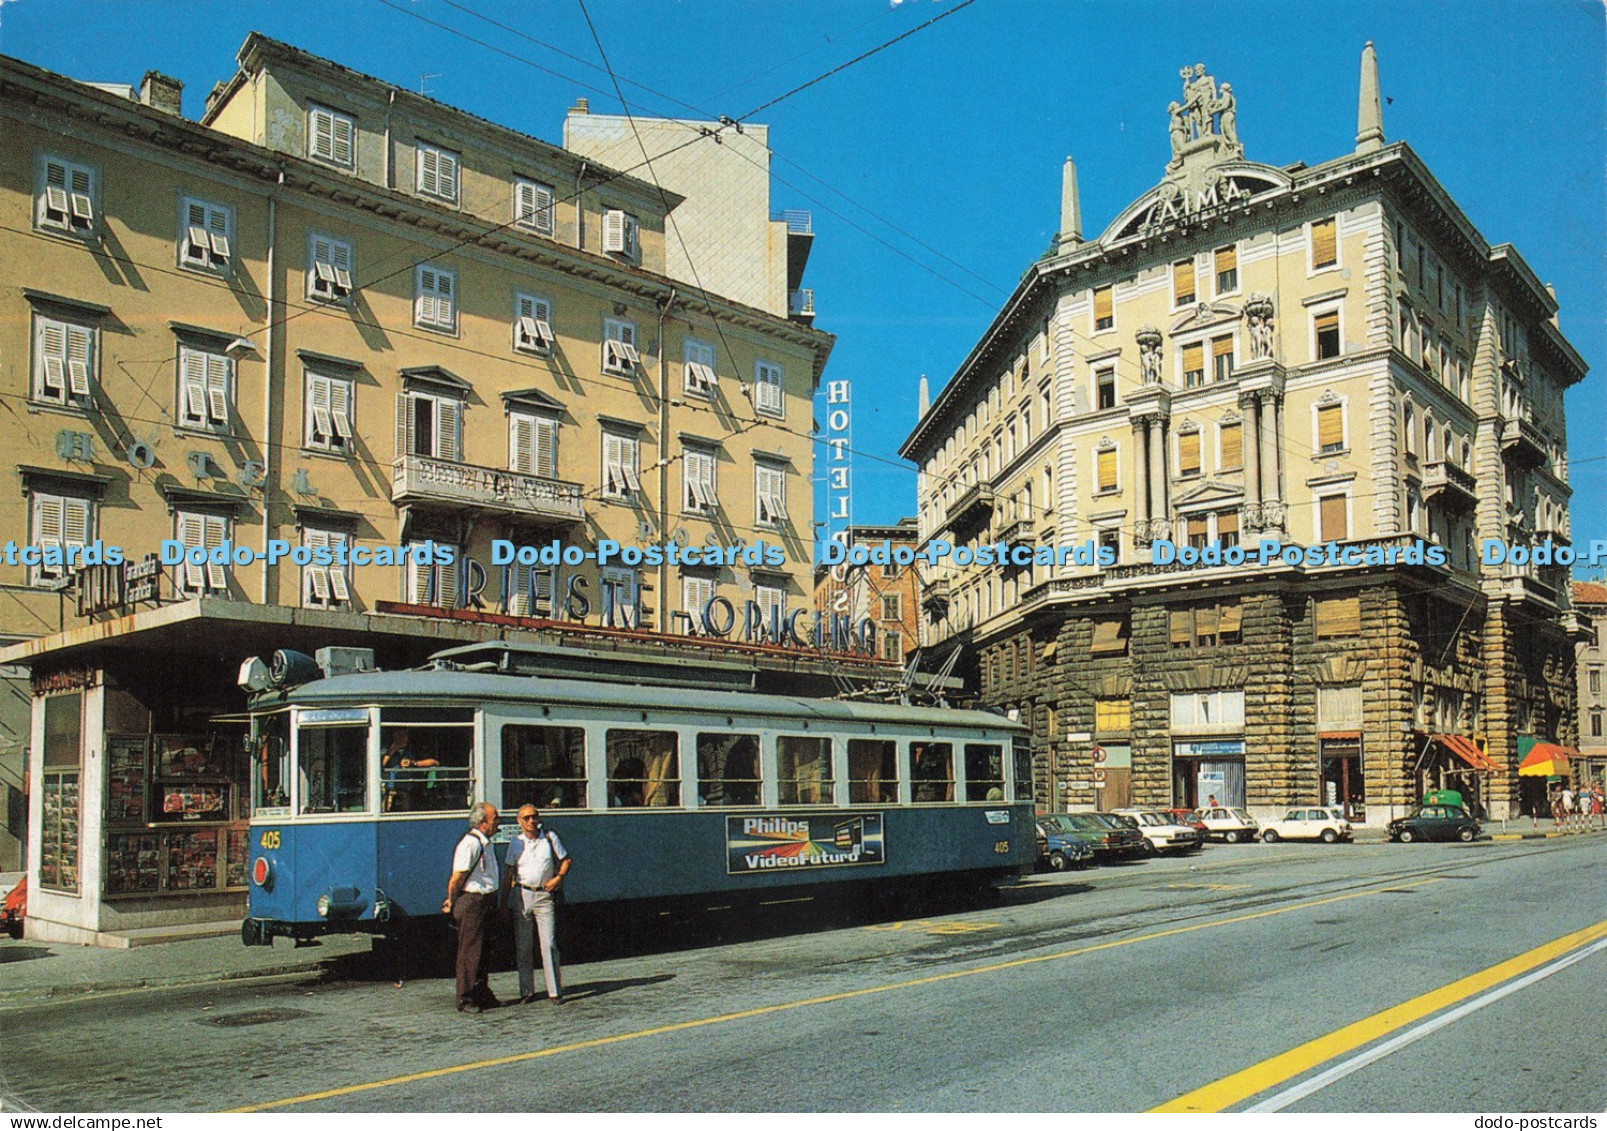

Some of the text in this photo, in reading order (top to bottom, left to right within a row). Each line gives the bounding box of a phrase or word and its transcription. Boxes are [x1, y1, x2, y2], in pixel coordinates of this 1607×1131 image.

[61, 429, 318, 495] HOTEL
[743, 817, 809, 836] Philips
[261, 830, 280, 849] 405
[995, 841, 1009, 853] 405
